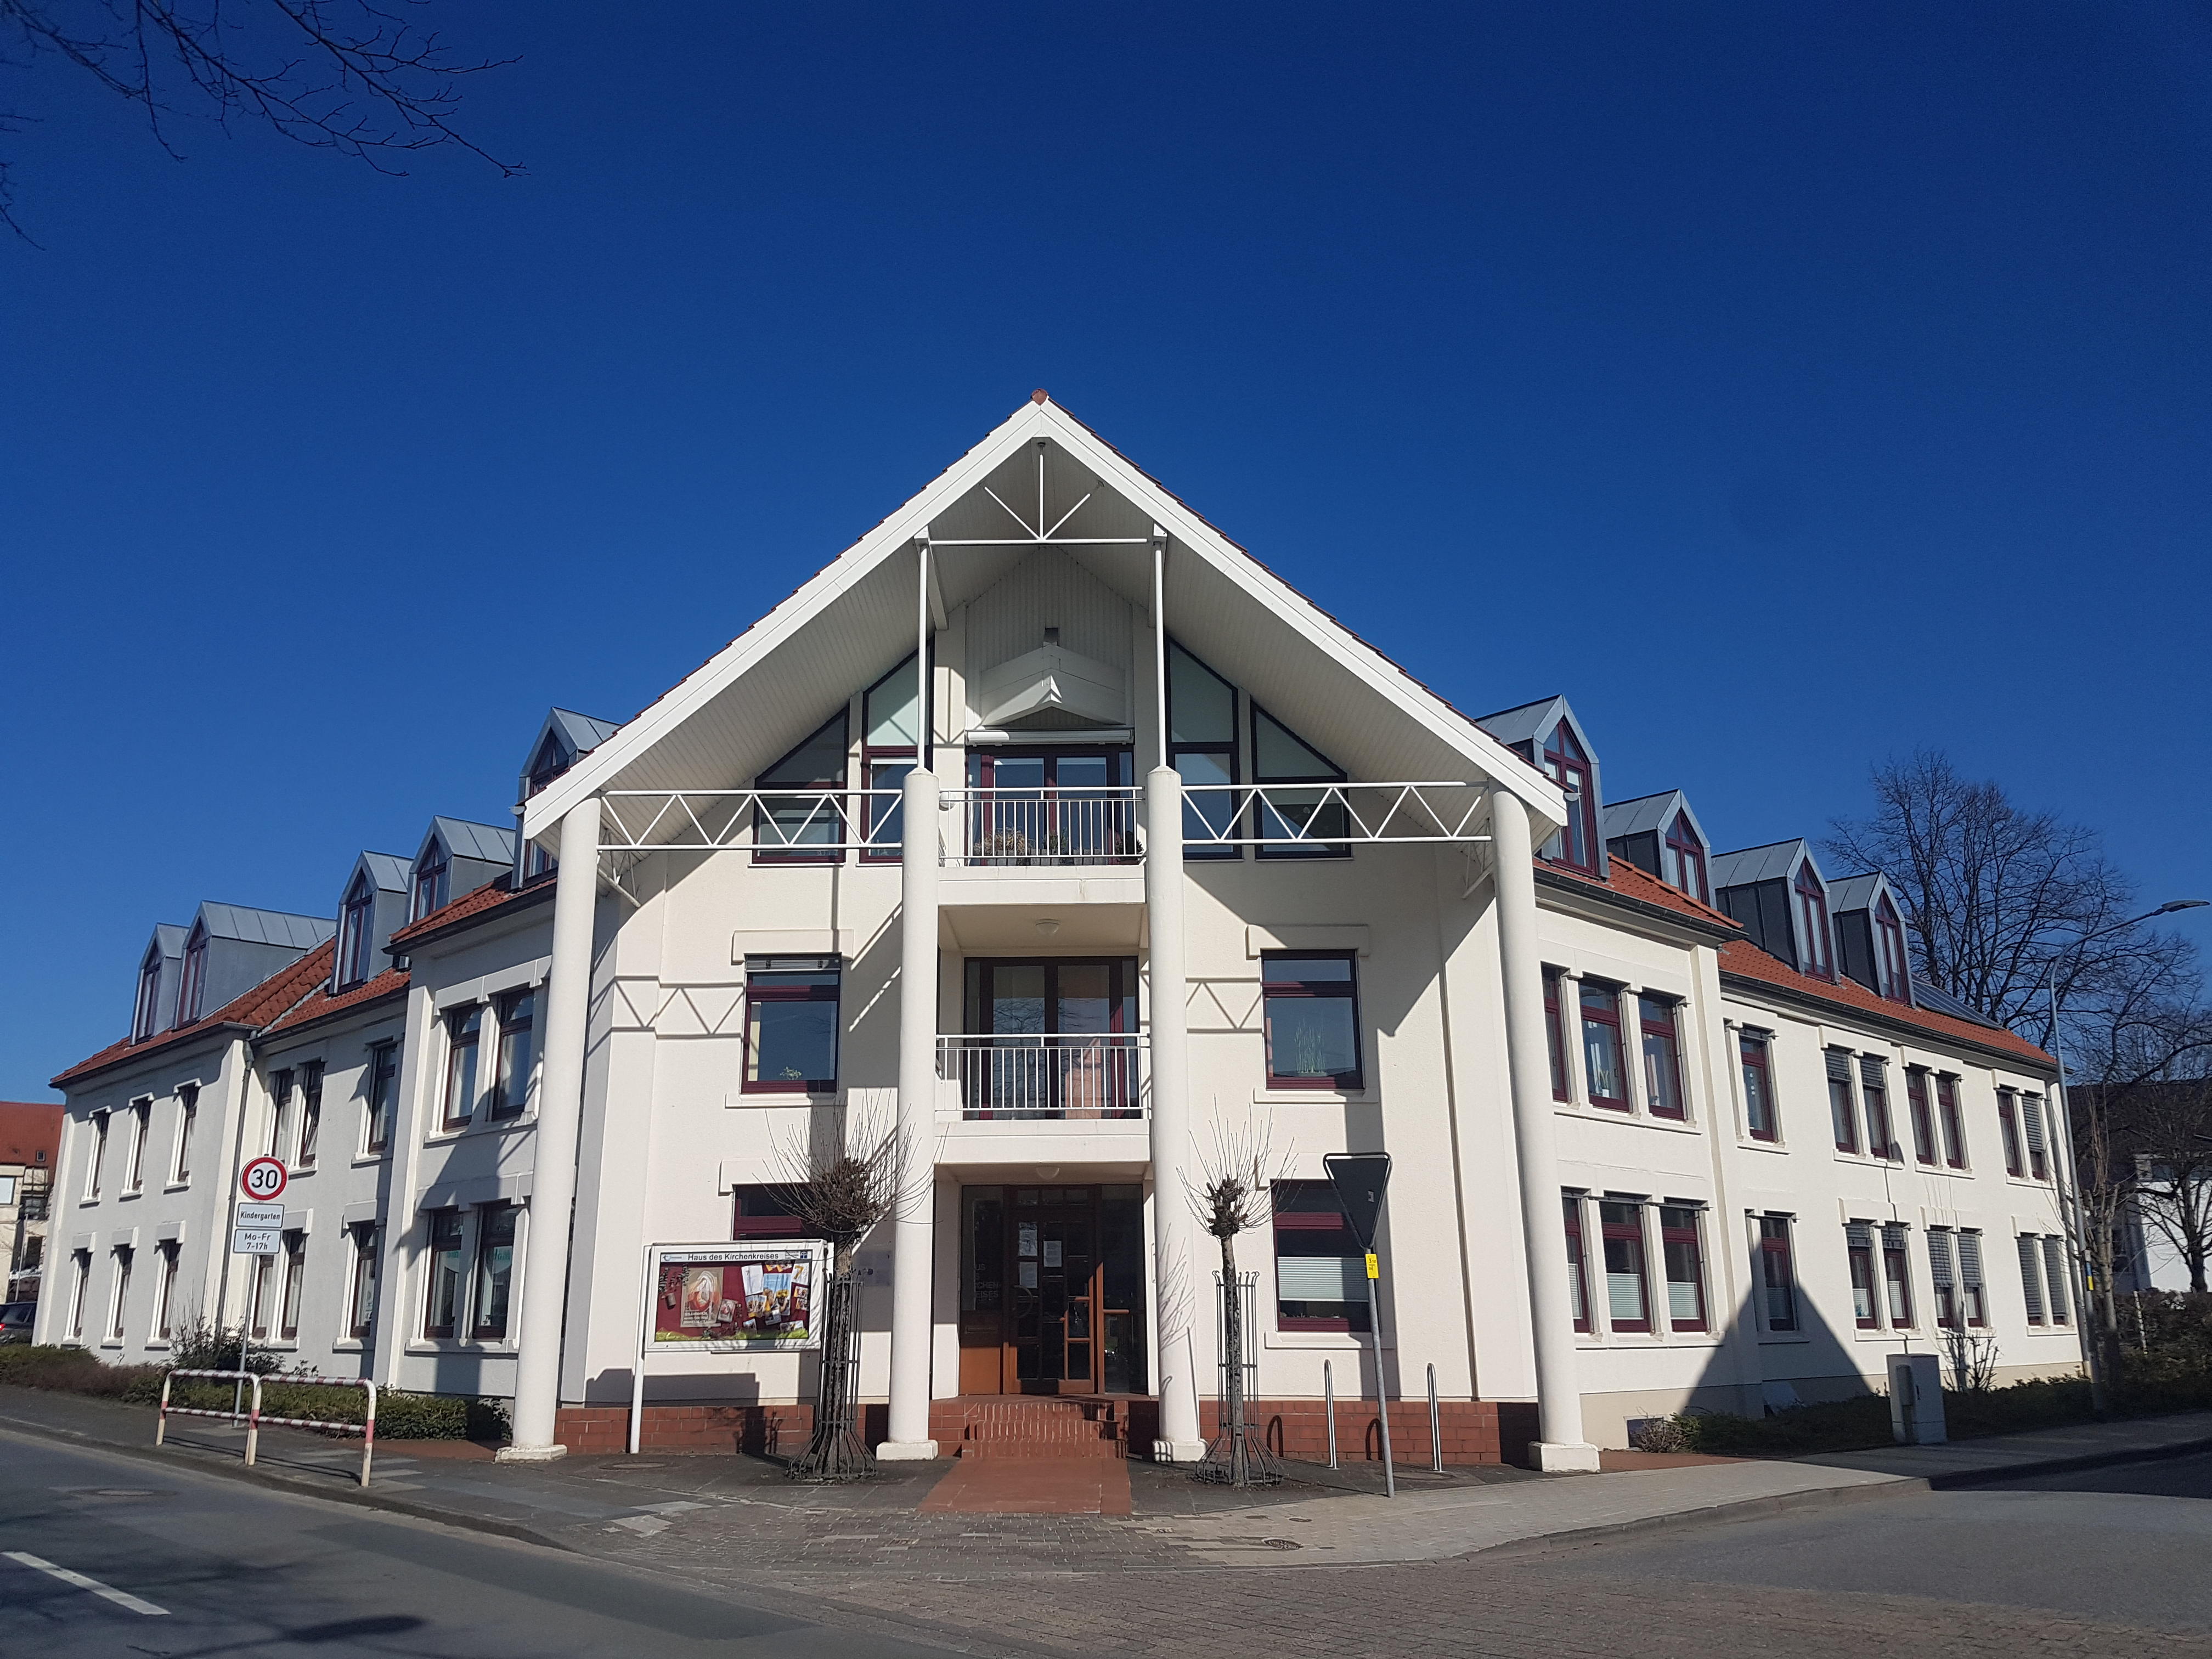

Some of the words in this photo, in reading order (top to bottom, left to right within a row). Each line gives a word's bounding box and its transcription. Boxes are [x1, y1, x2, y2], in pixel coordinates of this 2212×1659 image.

[251, 1169, 278, 1189] 30
[240, 1211, 280, 1221] Kindergarten
[244, 1233, 271, 1241] Mo-Fr
[246, 1242, 268, 1250] 7-17h
